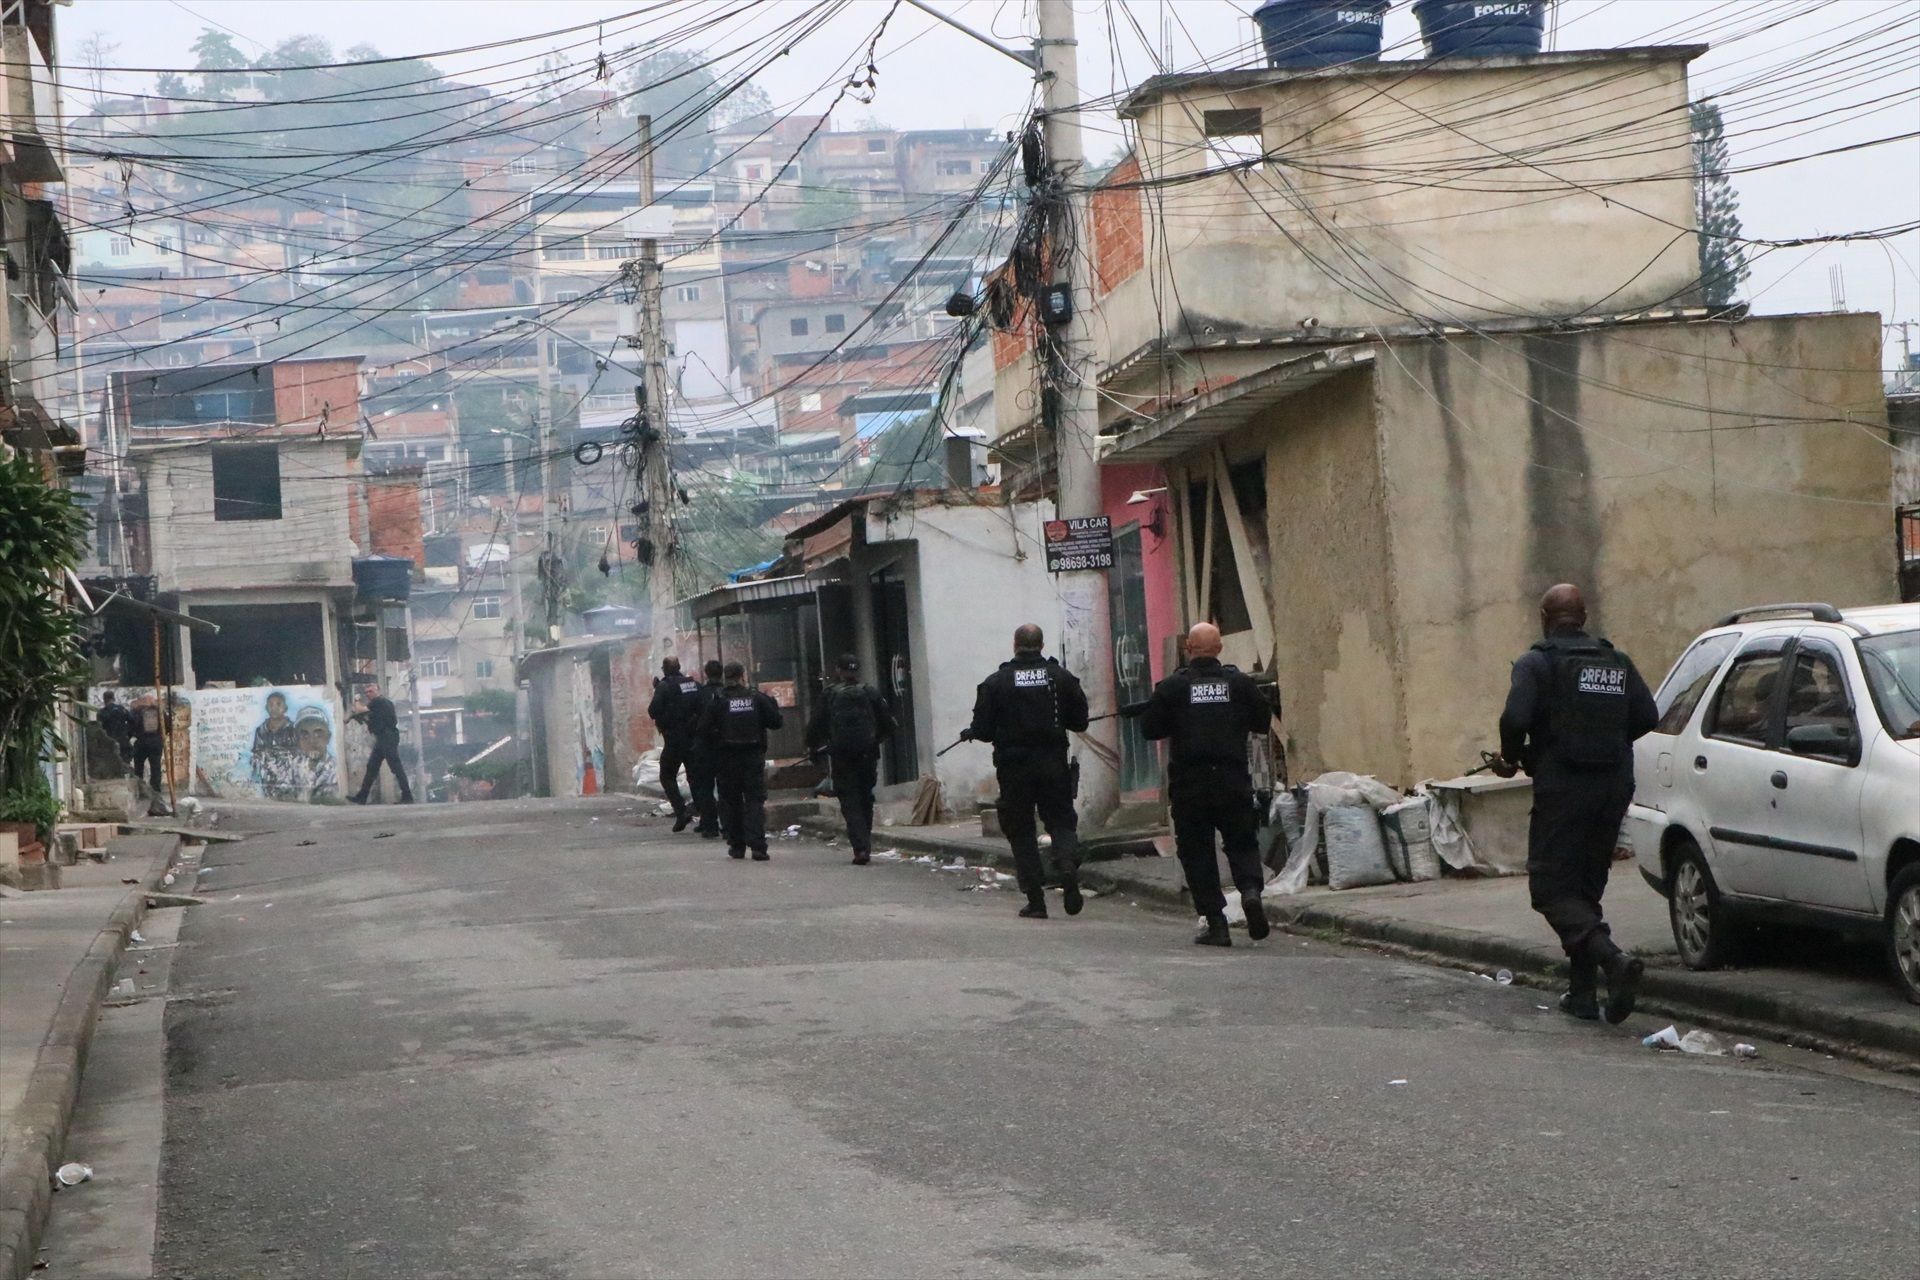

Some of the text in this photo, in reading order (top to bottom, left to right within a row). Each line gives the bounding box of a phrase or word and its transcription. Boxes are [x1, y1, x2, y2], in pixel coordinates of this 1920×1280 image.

[1068, 518, 1108, 530] VILA CAR
[1015, 669, 1047, 681] DRFA-BF
[1580, 668, 1625, 684] DRFA-BF
[1192, 684, 1228, 697] DRFA-BF
